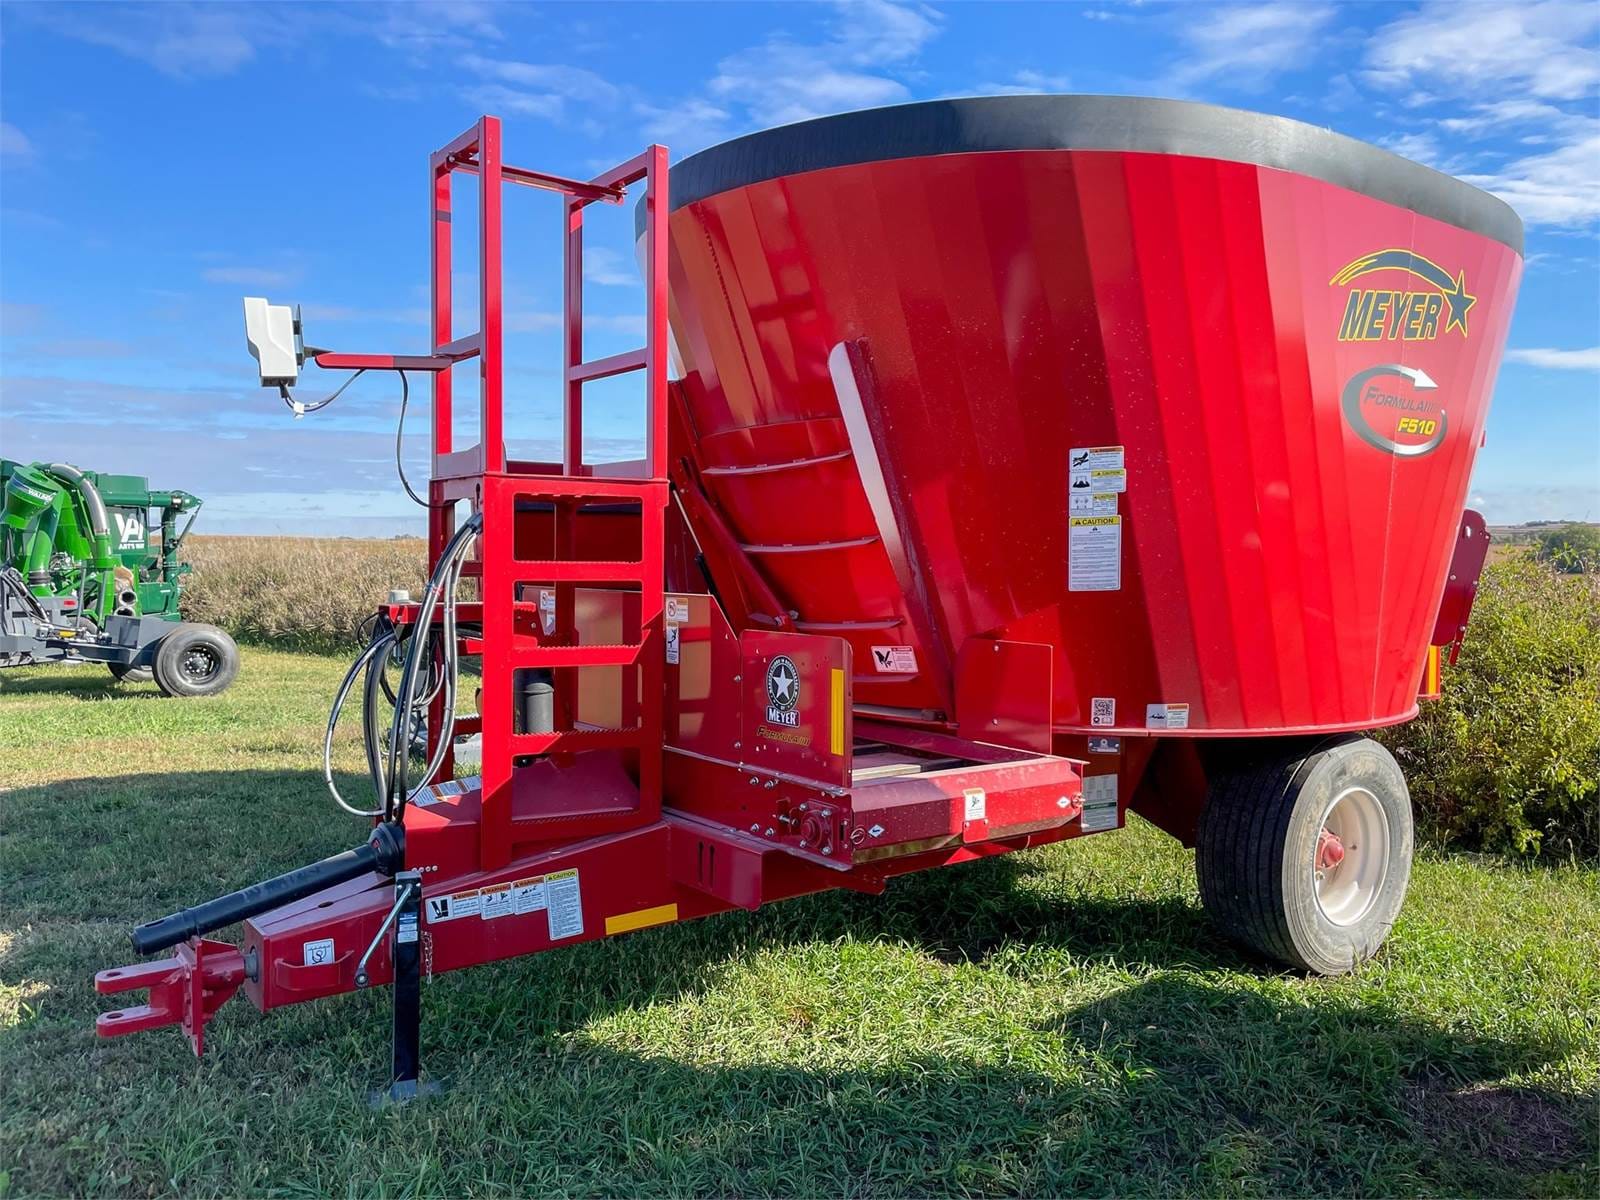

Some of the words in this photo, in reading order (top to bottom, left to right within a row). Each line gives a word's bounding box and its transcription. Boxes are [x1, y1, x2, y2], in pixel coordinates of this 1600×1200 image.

[1337, 289, 1443, 341] MEYER
[1397, 417, 1436, 436] F510
[1082, 518, 1114, 526] CAUTION
[768, 708, 796, 725] MEYER
[552, 871, 577, 879] CAUTION
